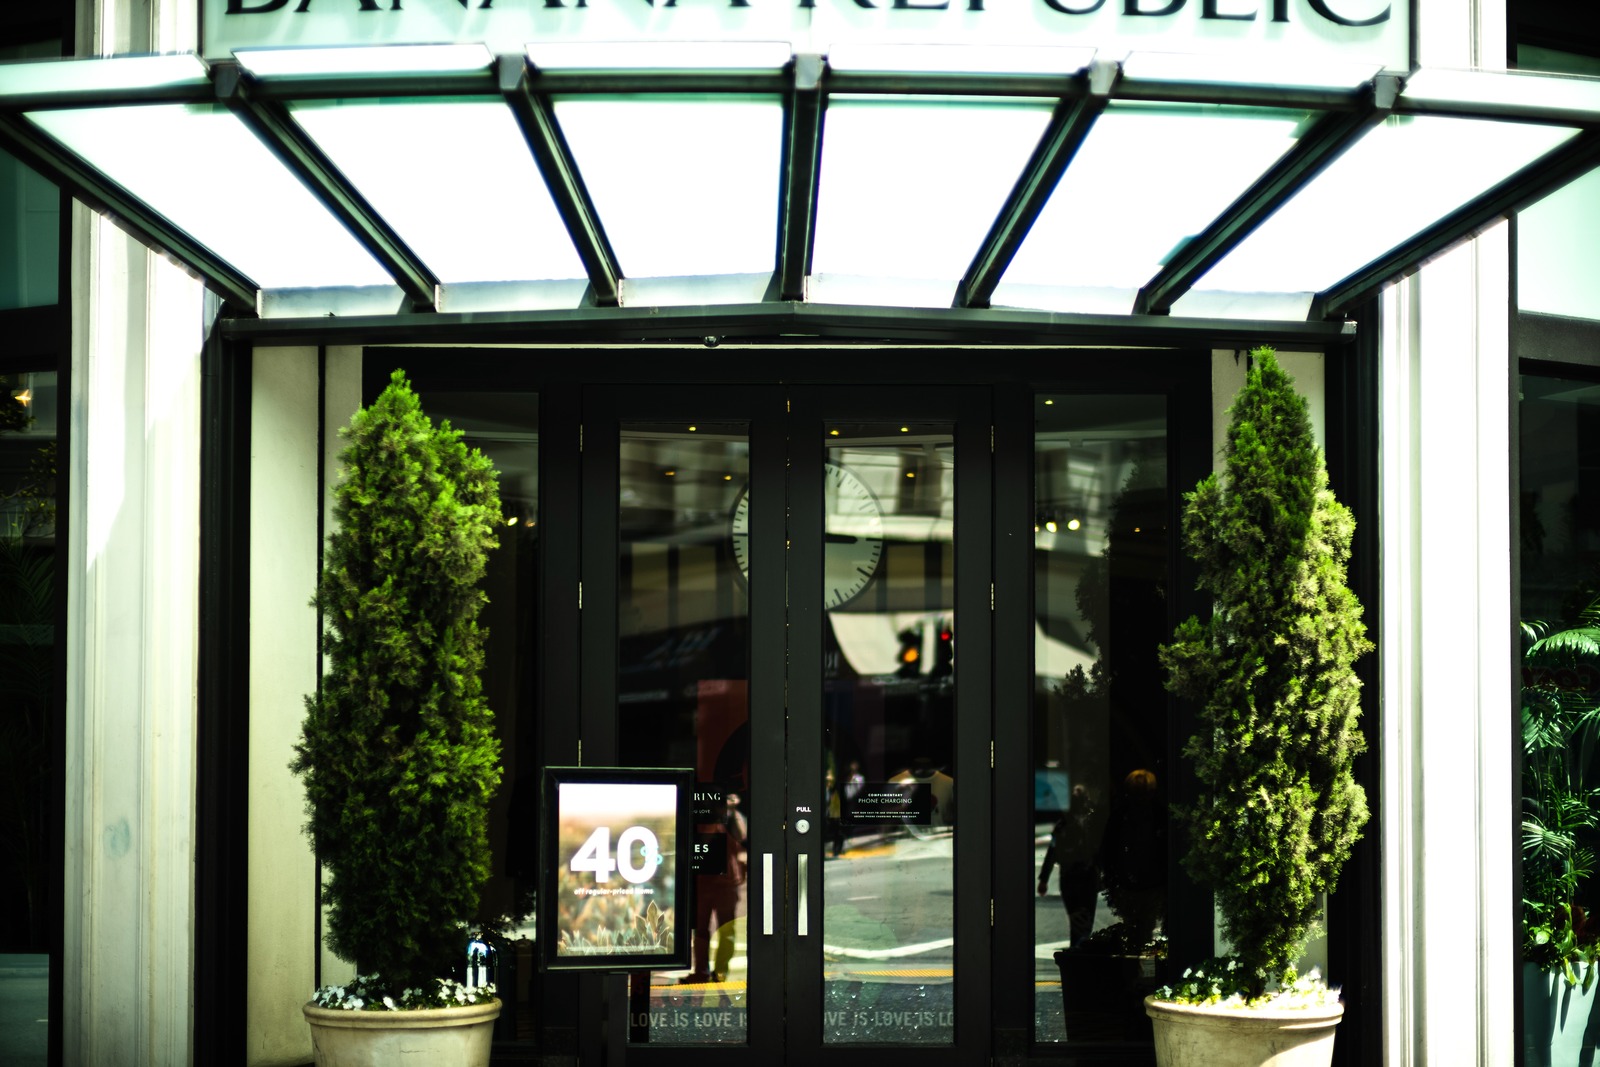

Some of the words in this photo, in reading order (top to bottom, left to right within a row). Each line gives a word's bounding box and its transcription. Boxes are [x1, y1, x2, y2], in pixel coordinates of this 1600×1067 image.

[585, 888, 634, 896] regular-priced
[630, 1012, 668, 1027] LOVE
[674, 1012, 689, 1027] IS
[694, 1012, 732, 1027] LOVE
[854, 1011, 868, 1026] IS
[874, 1011, 912, 1026] LOVE
[918, 1011, 933, 1026] IS
